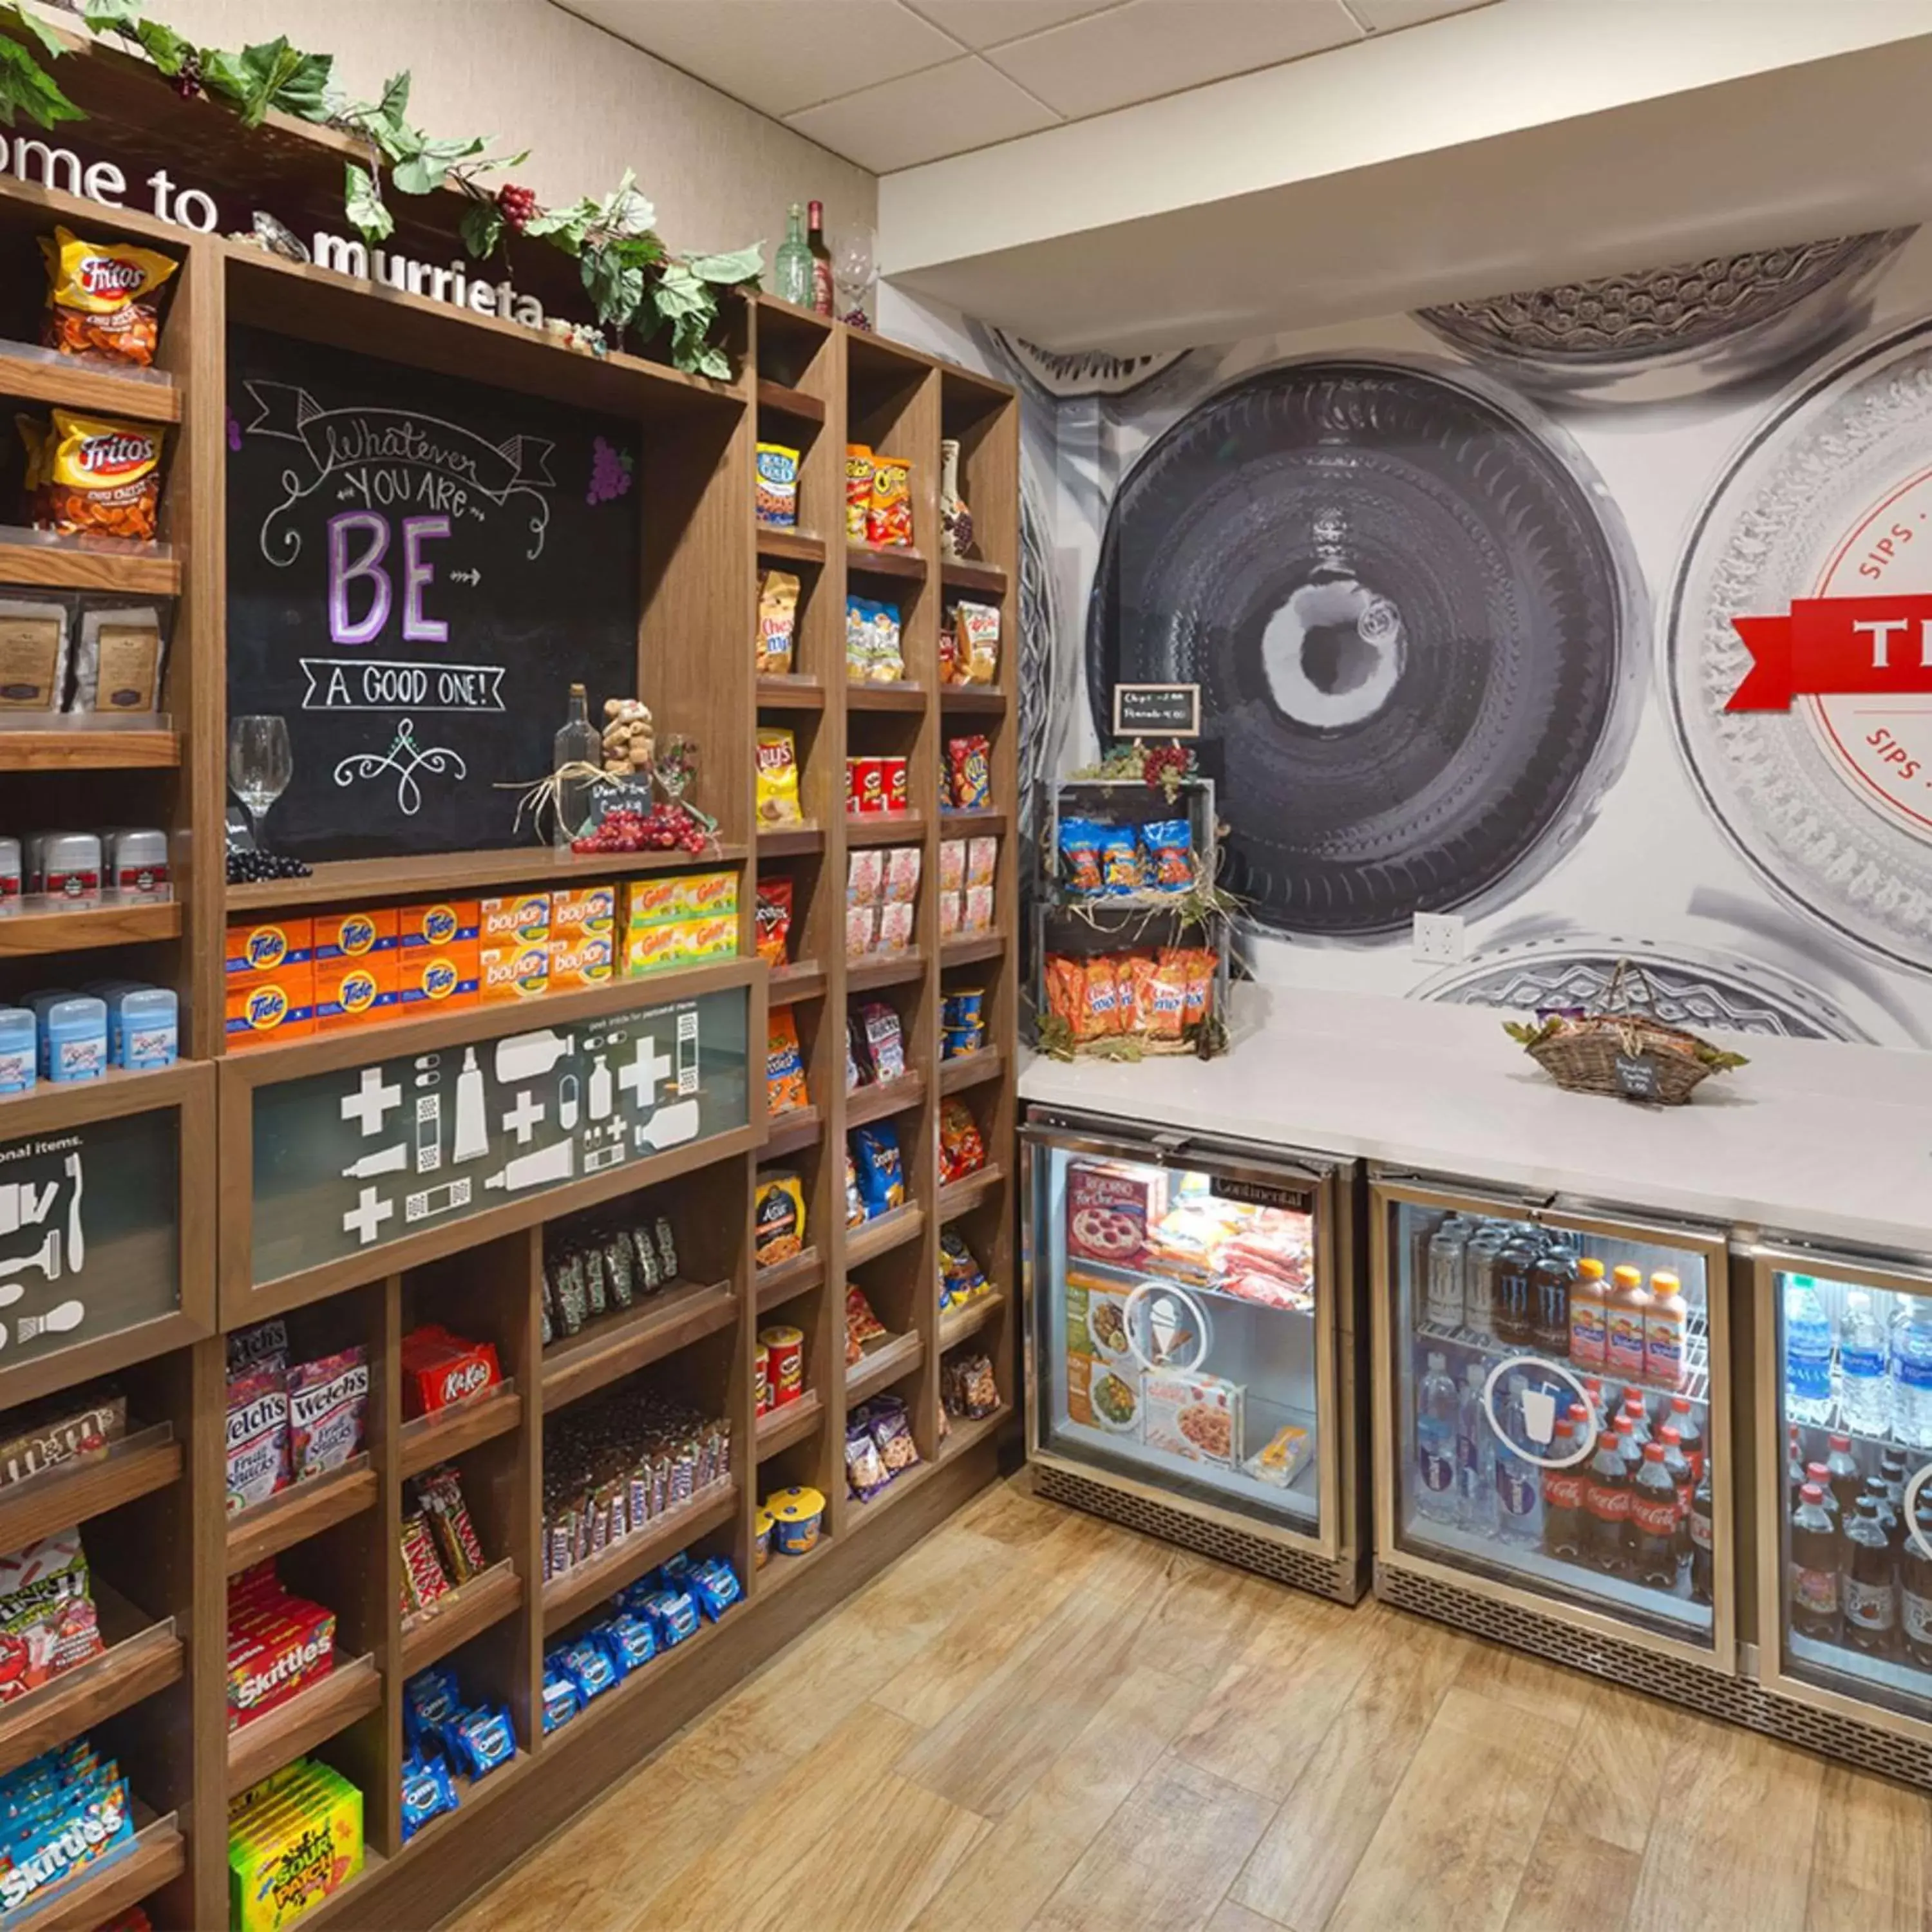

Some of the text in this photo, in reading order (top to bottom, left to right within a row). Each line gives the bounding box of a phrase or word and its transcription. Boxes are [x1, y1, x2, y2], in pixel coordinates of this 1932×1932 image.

[0, 133, 544, 330] me to murrieta
[80, 257, 145, 292] Fritos
[81, 433, 154, 471] Fritos
[325, 418, 478, 472] Whatever
[345, 470, 469, 516] YOU ARE
[1859, 523, 1913, 580] SIPS
[328, 511, 450, 643] BE
[326, 665, 488, 706] A GOOD ONE!
[1866, 727, 1921, 781] SIPS
[342, 923, 372, 949] Tide
[426, 913, 454, 937] Tide
[250, 937, 283, 961] Tide
[343, 981, 373, 1005] Tide
[426, 967, 454, 991] Tide
[250, 996, 284, 1022] Tide
[35, 1136, 83, 1154] items.
[295, 1371, 366, 1419] Welch's
[238, 1636, 332, 1708] Skittles
[1, 1806, 124, 1908] Skittles
[276, 1836, 332, 1884] SOUR
